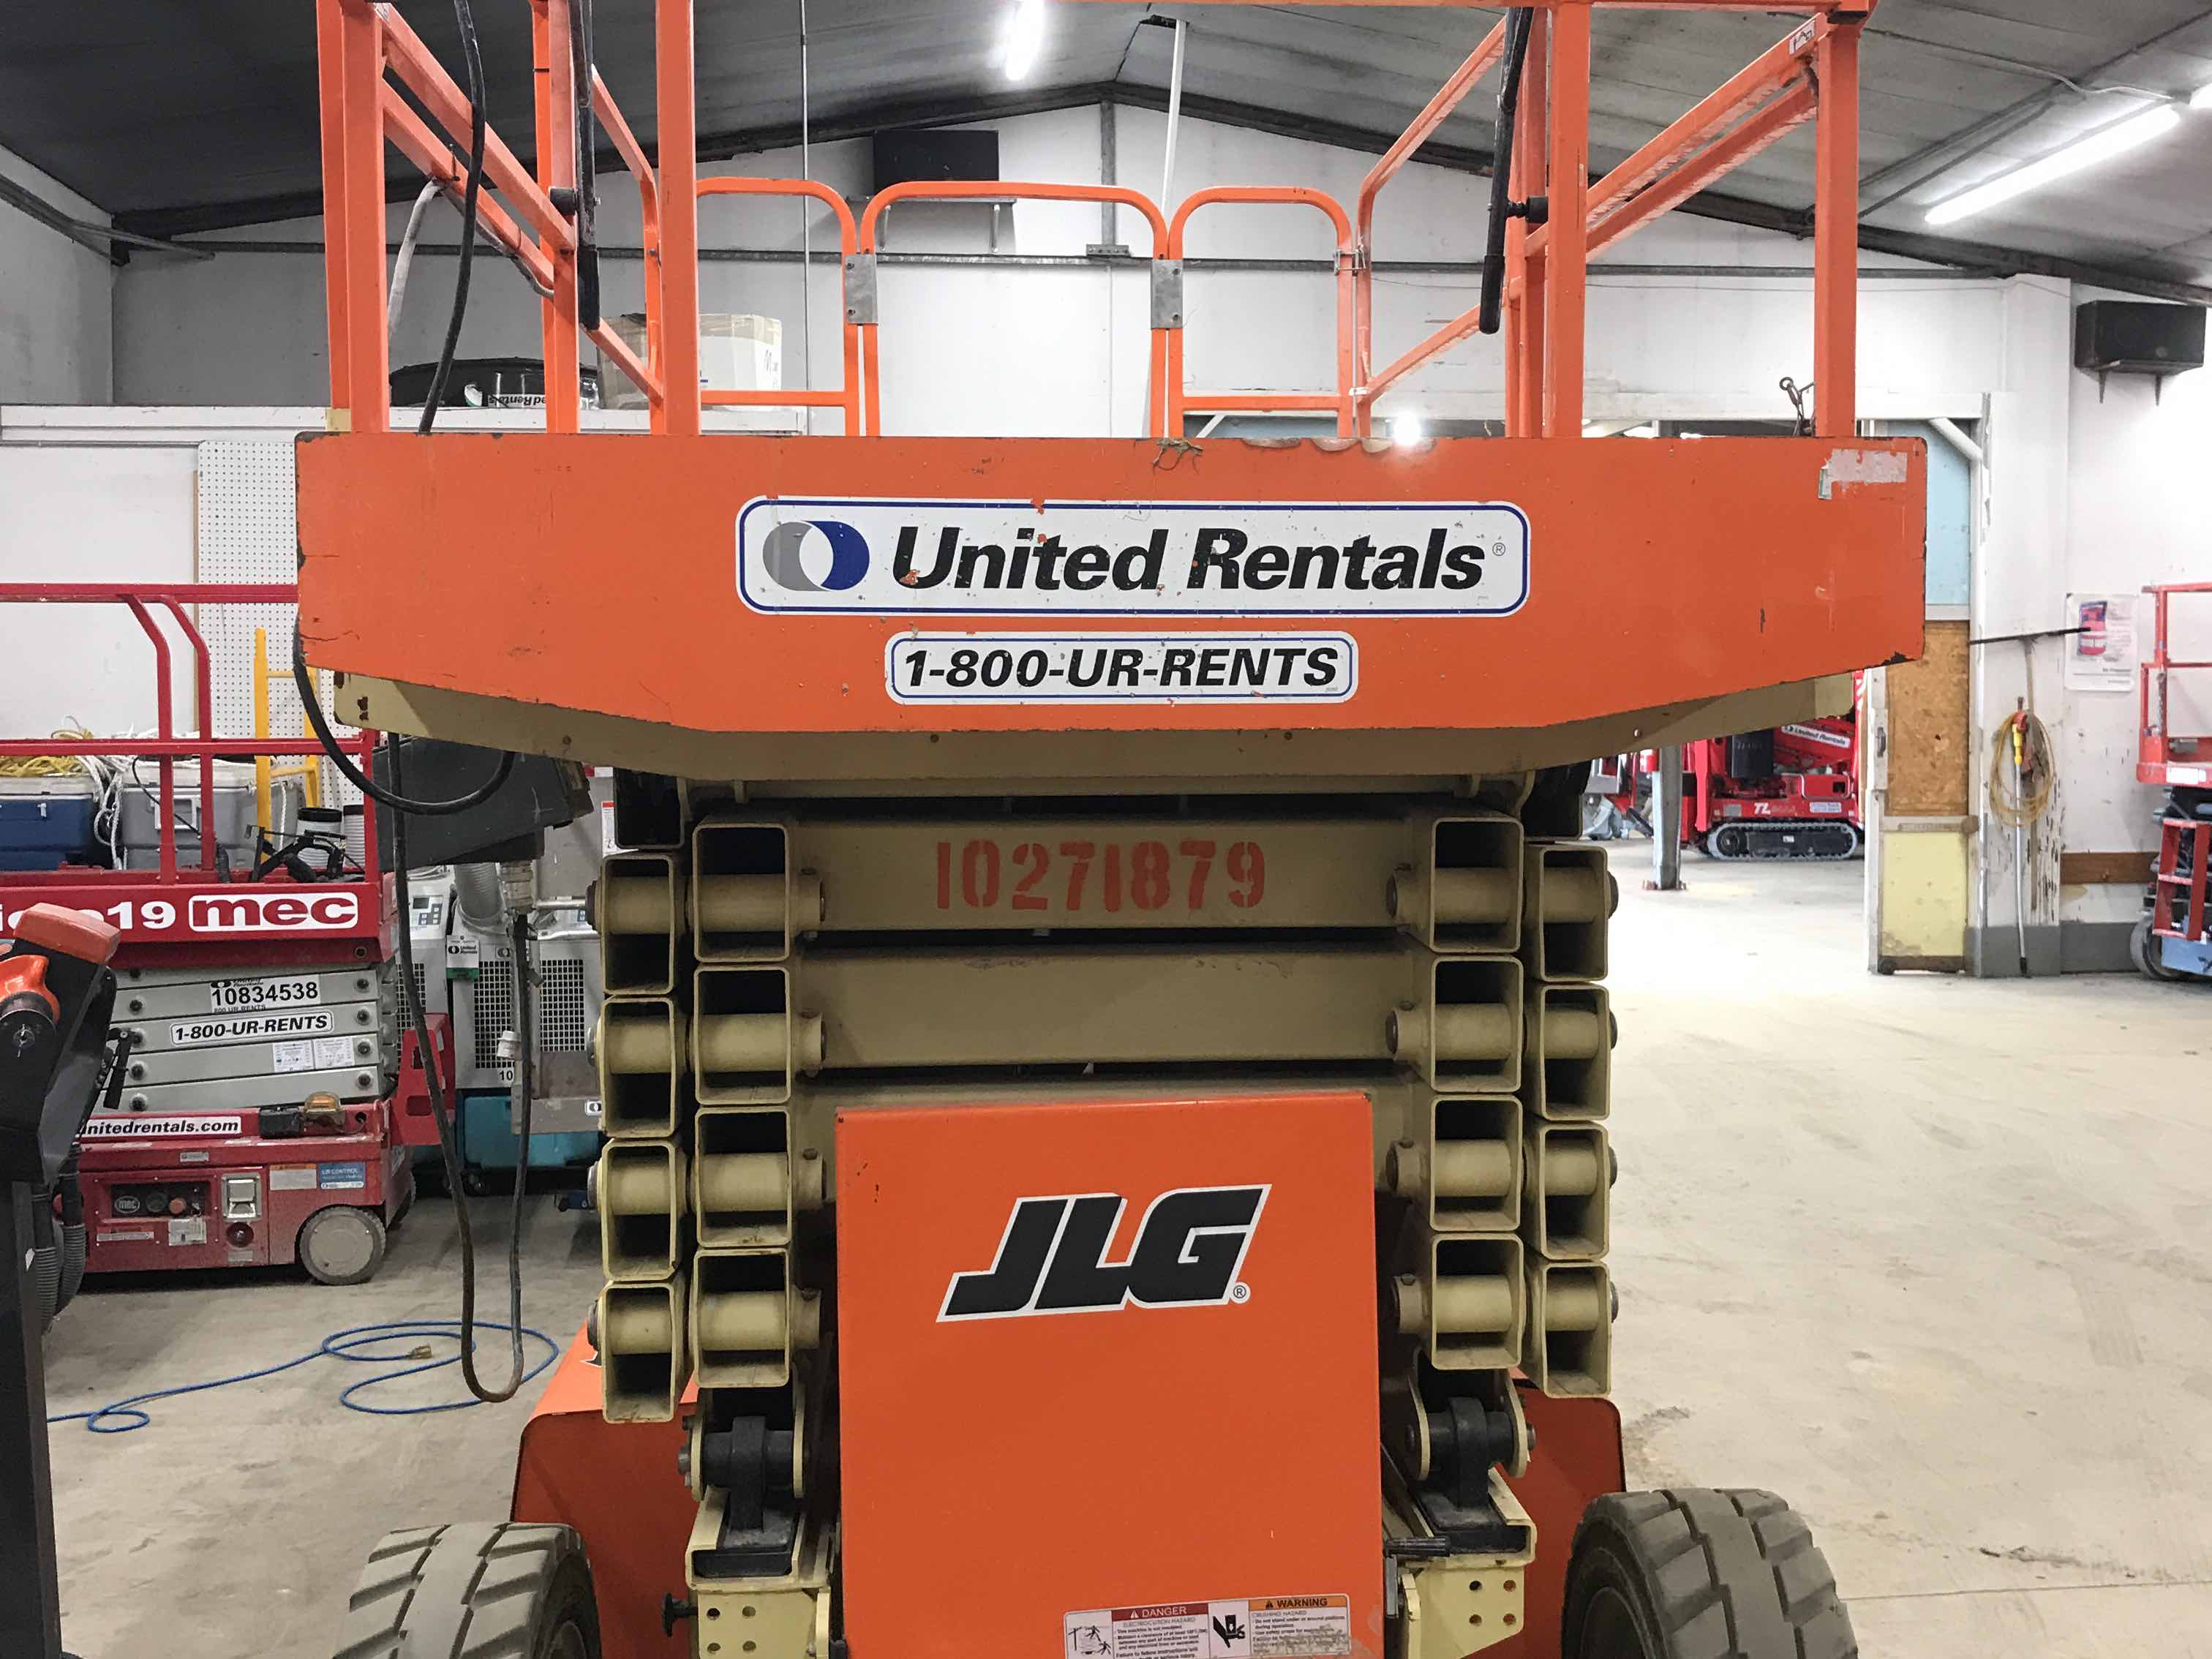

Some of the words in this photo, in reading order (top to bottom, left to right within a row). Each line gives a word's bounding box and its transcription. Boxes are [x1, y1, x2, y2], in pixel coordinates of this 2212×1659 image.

[892, 526, 1169, 591] United
[1186, 527, 1486, 591] Rentals
[905, 647, 1338, 687] 1-800-UR-RENTS
[937, 838, 1265, 913] 10271879
[192, 896, 357, 928] mec
[211, 981, 318, 1006] 10834538
[175, 1015, 328, 1041] 1-800-UR-RENTS
[936, 1184, 1272, 1323] JLG
[1141, 1606, 1187, 1618] DANGER
[1276, 1598, 1328, 1609] WARNING
